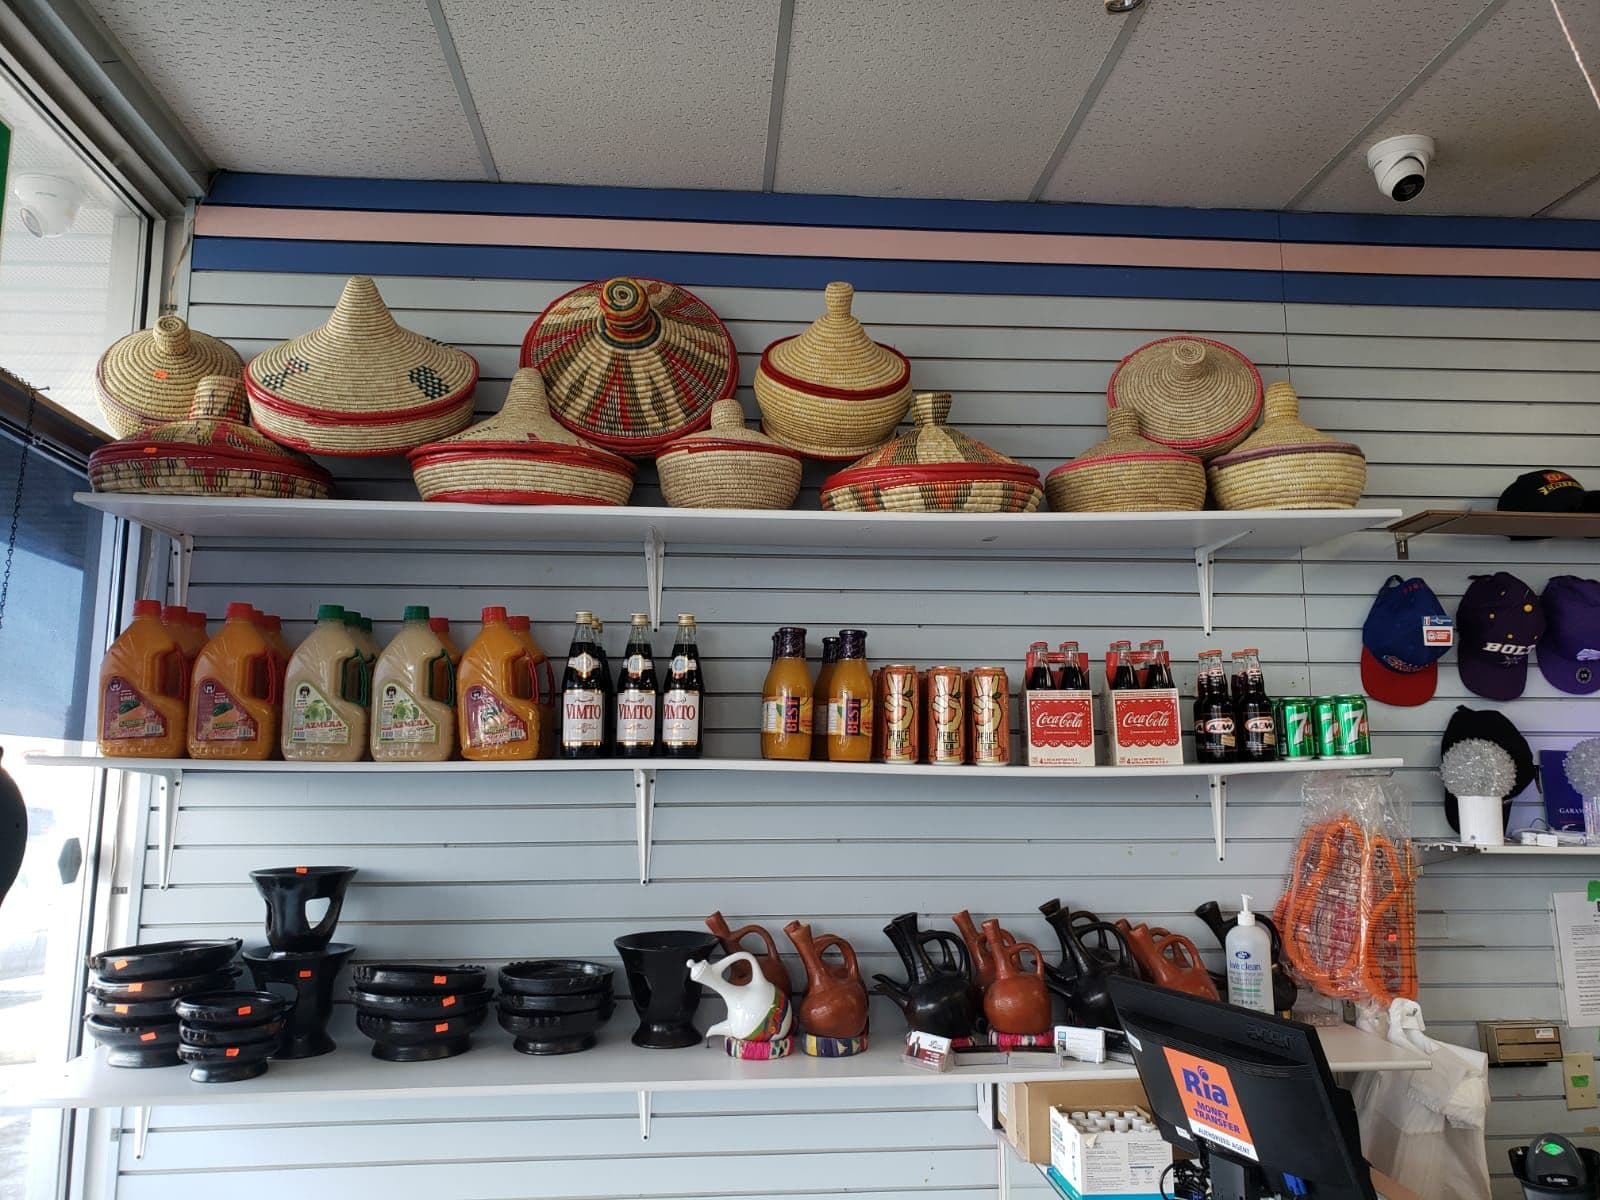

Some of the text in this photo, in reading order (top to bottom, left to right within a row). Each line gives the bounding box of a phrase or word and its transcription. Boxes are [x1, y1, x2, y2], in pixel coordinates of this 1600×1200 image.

[566, 704, 601, 720] VIMTO
[618, 704, 653, 720] VIMTO
[664, 704, 696, 720] VIMTO
[786, 700, 798, 732] BEST
[847, 701, 859, 733] BEST
[1036, 711, 1085, 728] Coca-Cola
[1123, 711, 1172, 728] Coca-Cola
[305, 720, 342, 728] AZMERA
[393, 719, 429, 728] AZMERA
[888, 730, 909, 741] PEACE
[939, 730, 959, 741] PEACE
[977, 732, 997, 742] PEACE
[1241, 961, 1262, 970] clean
[1182, 1065, 1228, 1107] Ria
[1196, 1101, 1229, 1119] MONEY
[1193, 1108, 1241, 1134] TRANSFER
[1231, 1142, 1250, 1155] AGENT
